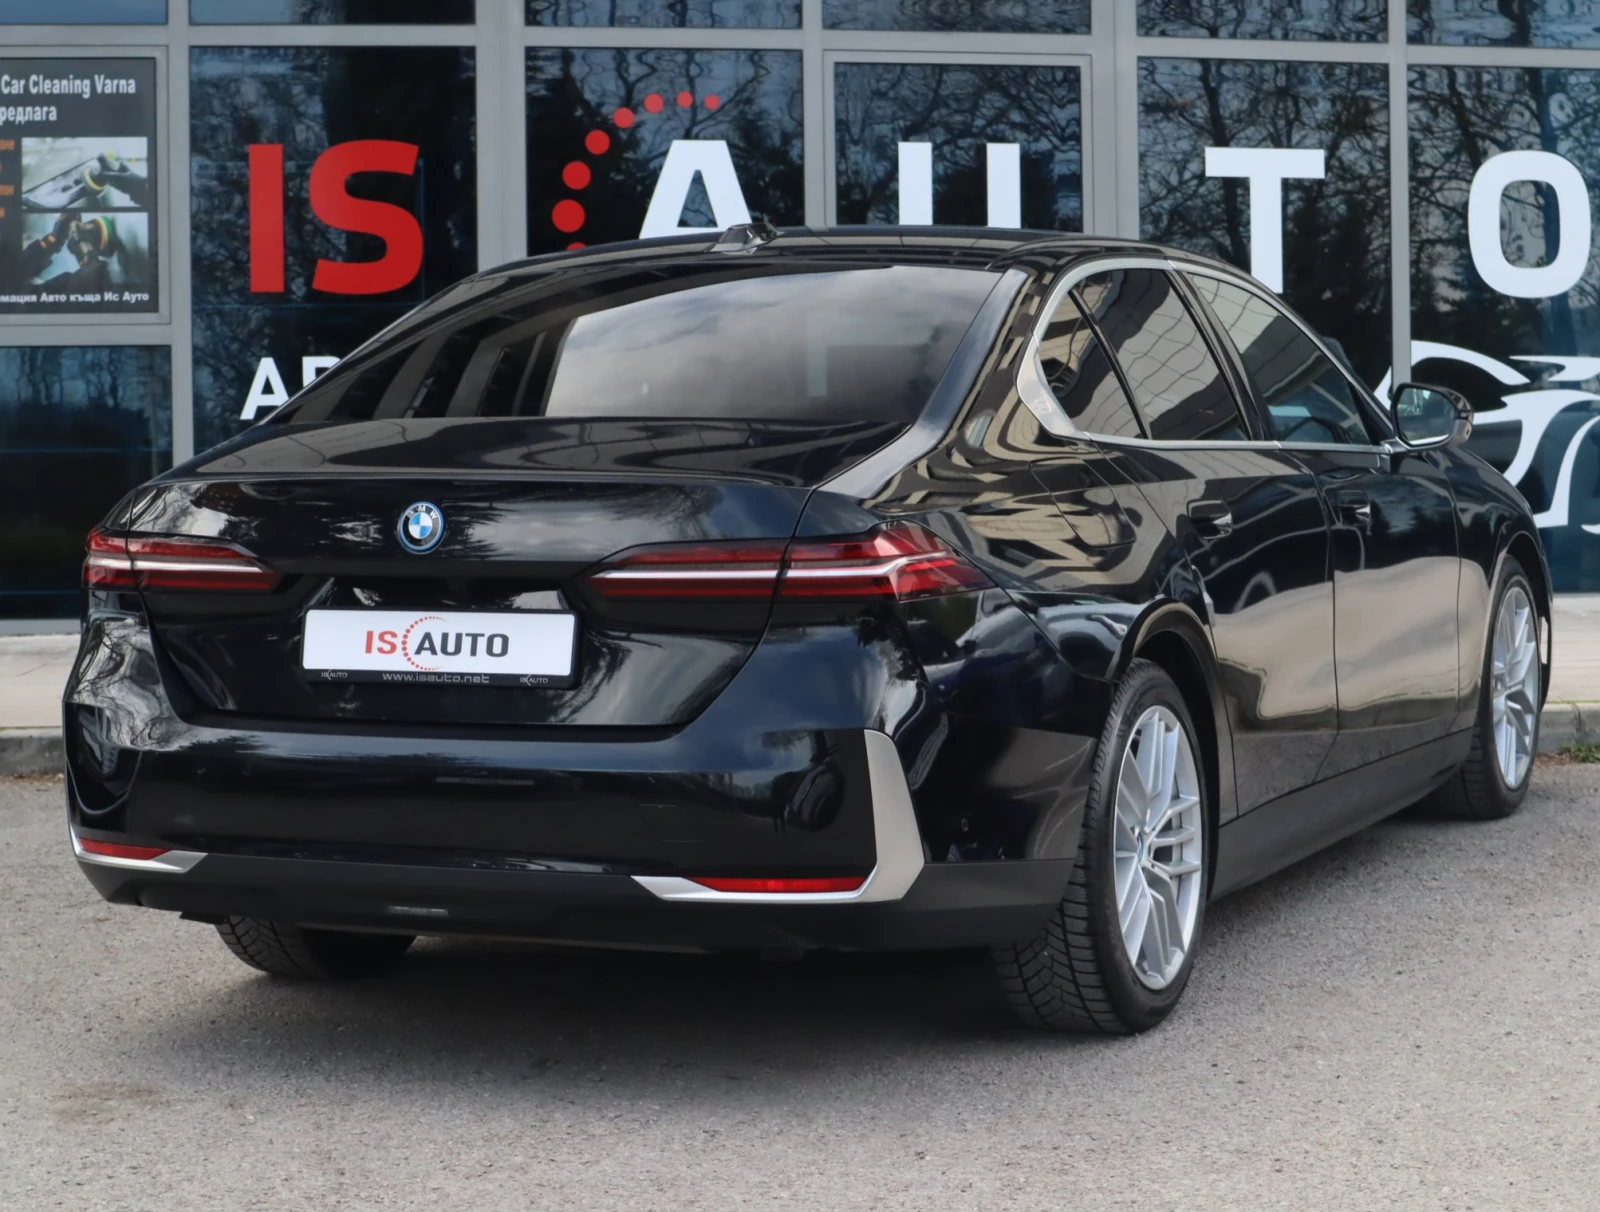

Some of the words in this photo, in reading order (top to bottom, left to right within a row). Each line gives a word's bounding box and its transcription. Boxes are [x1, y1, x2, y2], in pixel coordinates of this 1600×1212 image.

[0, 74, 26, 94] Car
[29, 74, 91, 99] Cleaning
[94, 74, 137, 94] Varna
[248, 139, 424, 295] IS
[0, 294, 37, 304] мация
[122, 291, 150, 304] Ауто
[406, 504, 439, 519] BMW
[364, 630, 398, 656] IS
[414, 631, 510, 658] AUTO
[382, 672, 490, 684] www.isauto.net
